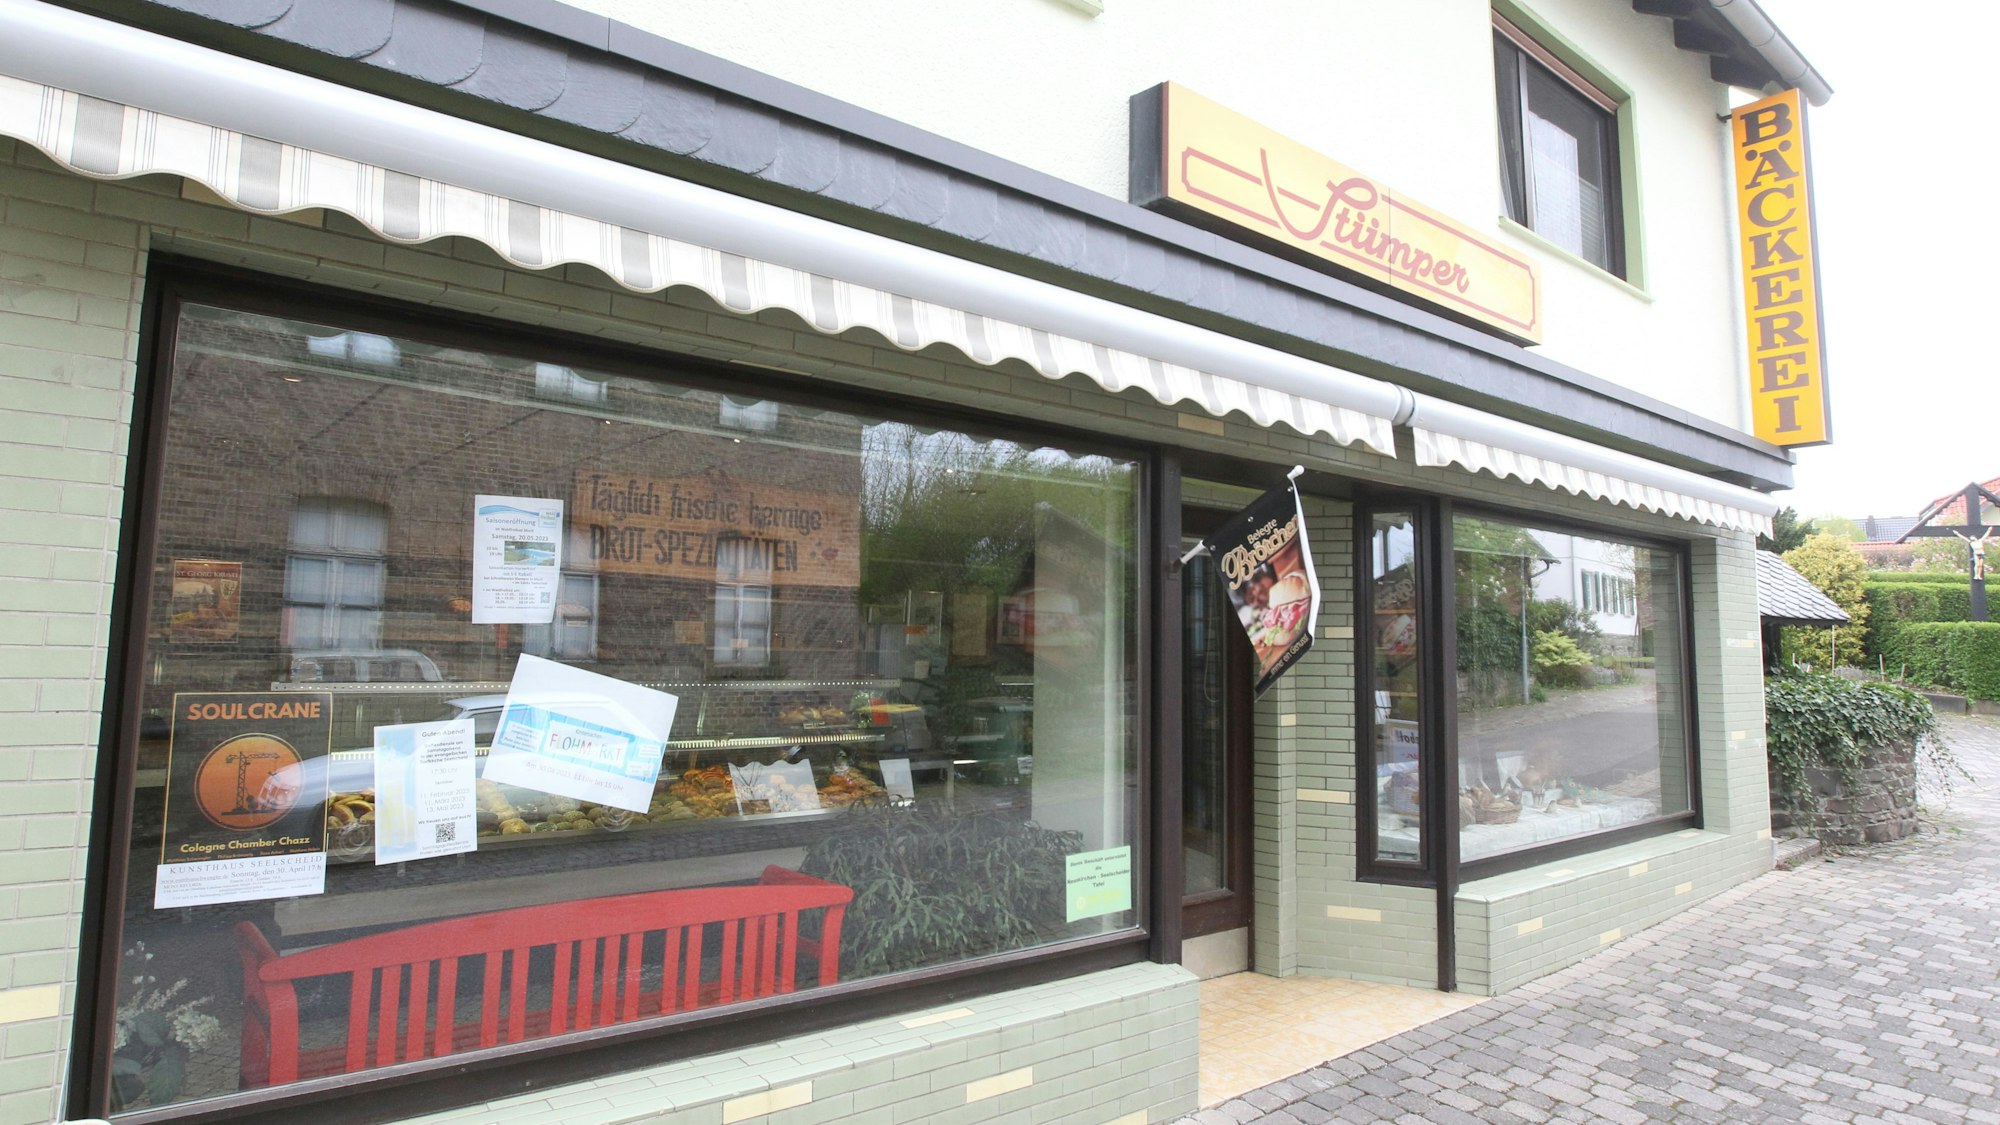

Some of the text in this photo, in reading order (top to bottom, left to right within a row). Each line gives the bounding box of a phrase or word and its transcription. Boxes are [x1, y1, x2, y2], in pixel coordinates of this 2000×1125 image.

[1260, 148, 1469, 293] Stümper
[1740, 103, 1810, 433] BÄCKEREI
[588, 474, 660, 521] Täglich
[1247, 519, 1278, 544] Belegte
[186, 702, 321, 720] SOULCRANE
[549, 733, 622, 764] FLOHMRKT
[180, 843, 226, 854] Cologne
[228, 839, 277, 850] Chamber
[279, 836, 310, 846] Chazz
[169, 855, 322, 875] KUNSTHAUS SEELSCHEID
[231, 870, 261, 878] Sonntag,
[288, 865, 306, 874] April
